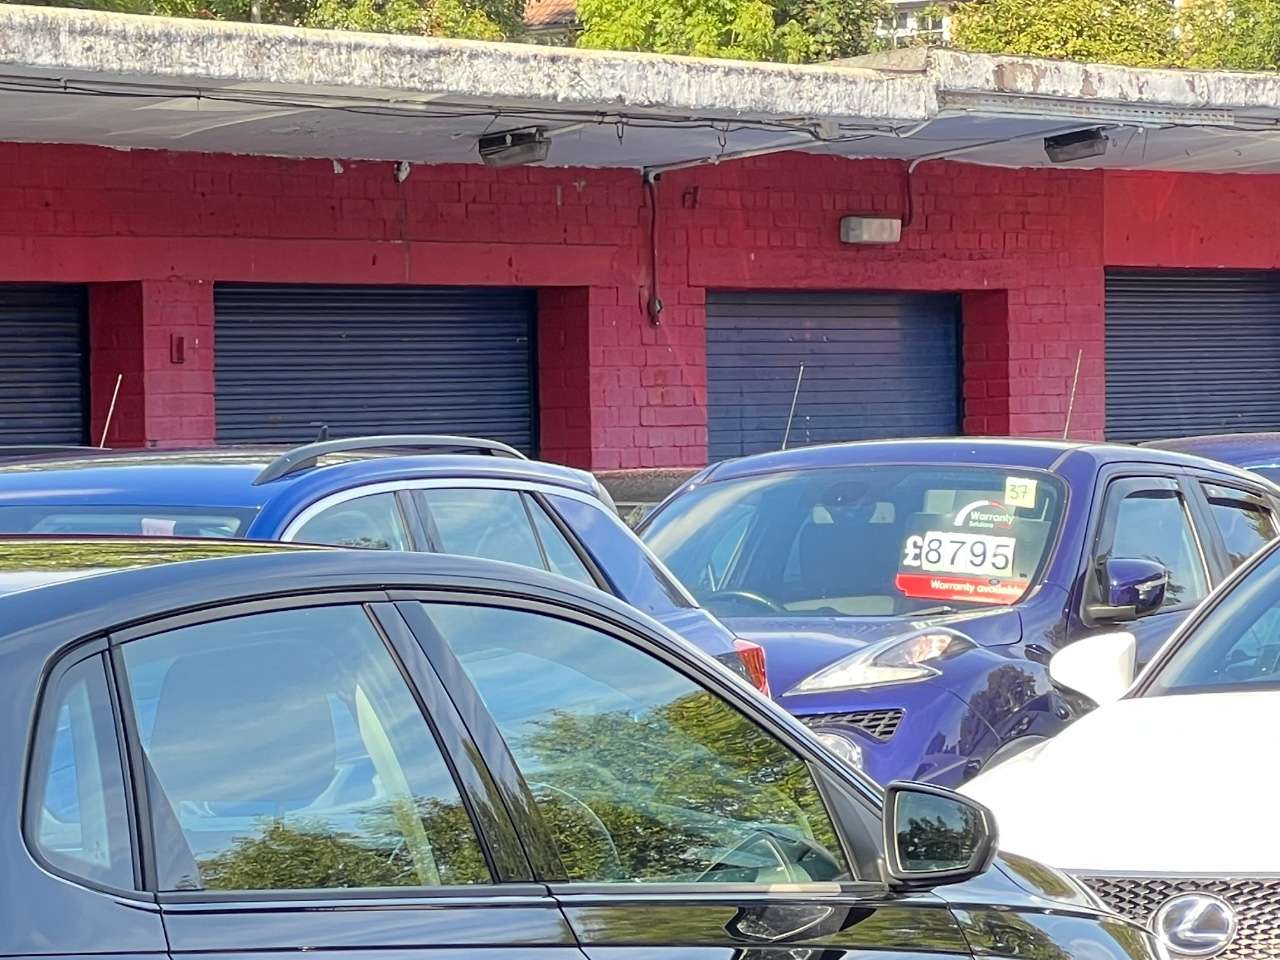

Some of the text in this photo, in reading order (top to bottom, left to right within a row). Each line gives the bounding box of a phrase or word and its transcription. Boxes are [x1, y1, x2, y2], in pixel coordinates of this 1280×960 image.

[1008, 484, 1028, 499] 37
[970, 511, 1015, 527] Warranty
[903, 535, 1010, 571] £8795
[930, 579, 975, 593] Warranty
